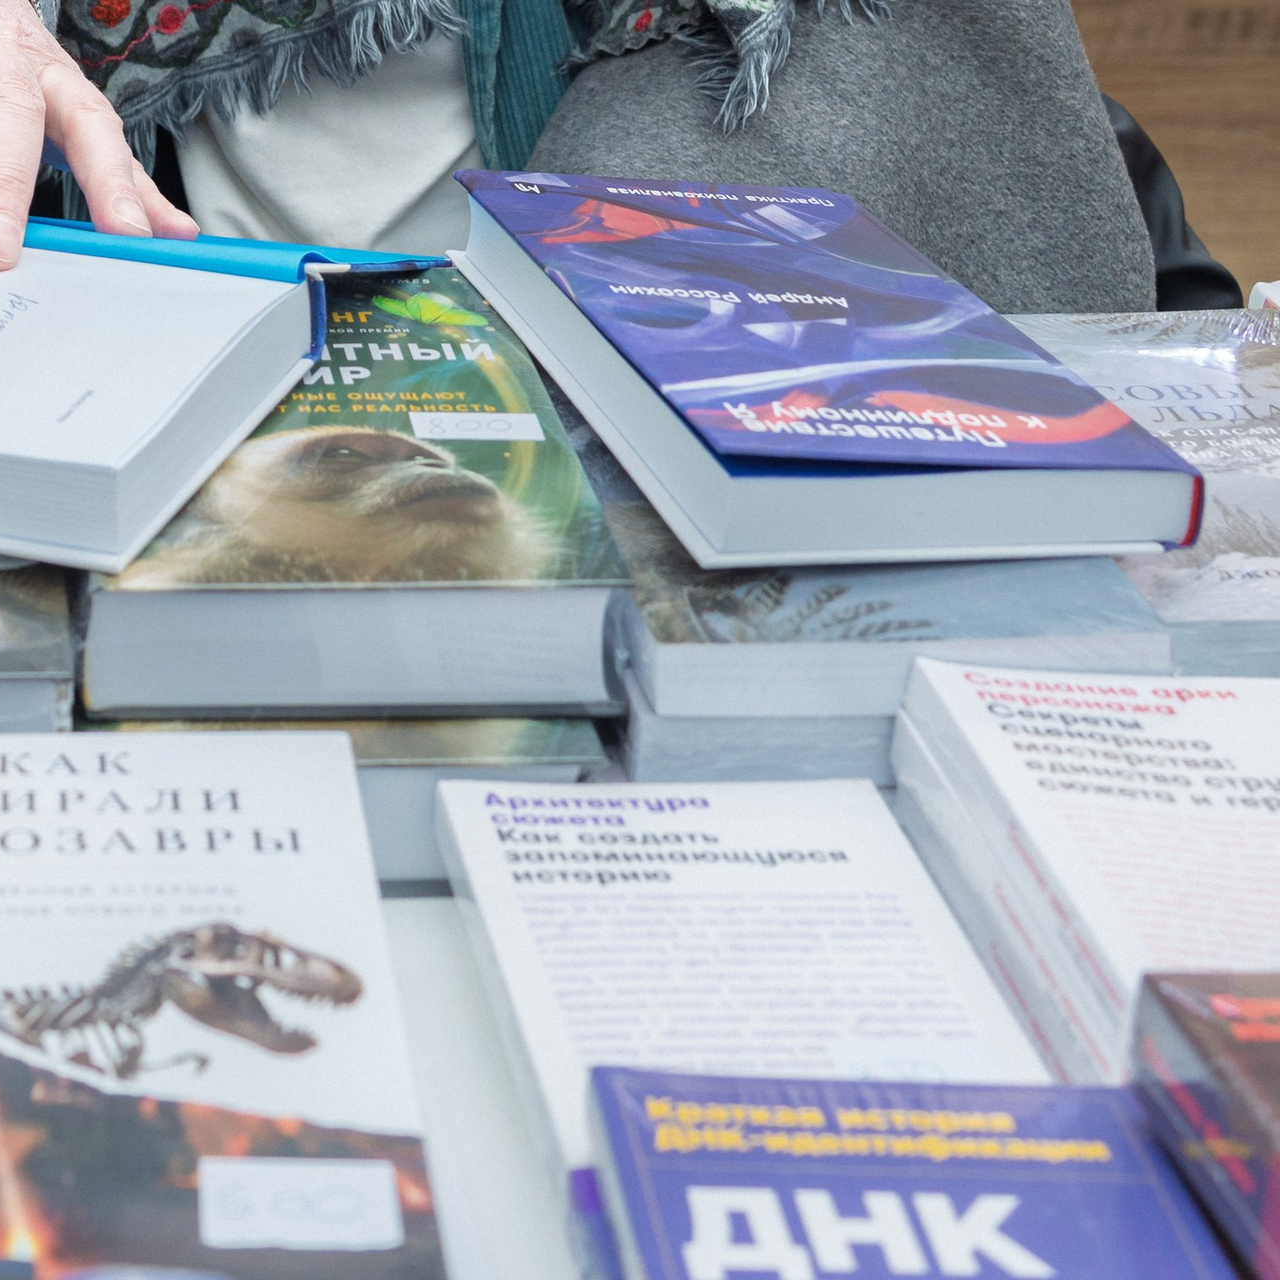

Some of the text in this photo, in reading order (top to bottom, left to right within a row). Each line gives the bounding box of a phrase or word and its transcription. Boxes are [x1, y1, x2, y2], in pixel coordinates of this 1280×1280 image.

[606, 186, 835, 208] Практика психоанализа
[609, 284, 850, 309] Андрей Россохин
[331, 311, 373, 324] НГ
[303, 366, 372, 385] ИР
[290, 392, 466, 402] НЫЕ ОЩУЩАЮТ
[297, 405, 341, 413] НАС
[352, 403, 496, 413] РЕАЛЬНОСТЬ
[722, 402, 757, 420] Я
[770, 401, 1008, 429] подлинному
[430, 417, 513, 436] 800
[740, 419, 1007, 447] Путешествие
[963, 671, 1237, 702] Создание арки
[976, 690, 1177, 715] персонажа
[987, 703, 1144, 730] Секреты
[1000, 724, 1213, 751] сценарного
[484, 792, 711, 812] Архитектура
[490, 813, 626, 827] сюжета
[497, 828, 720, 846] Как создать
[504, 849, 850, 867] запоминающуюся
[511, 869, 673, 885] историю
[680, 1184, 1060, 1280] ДНК
